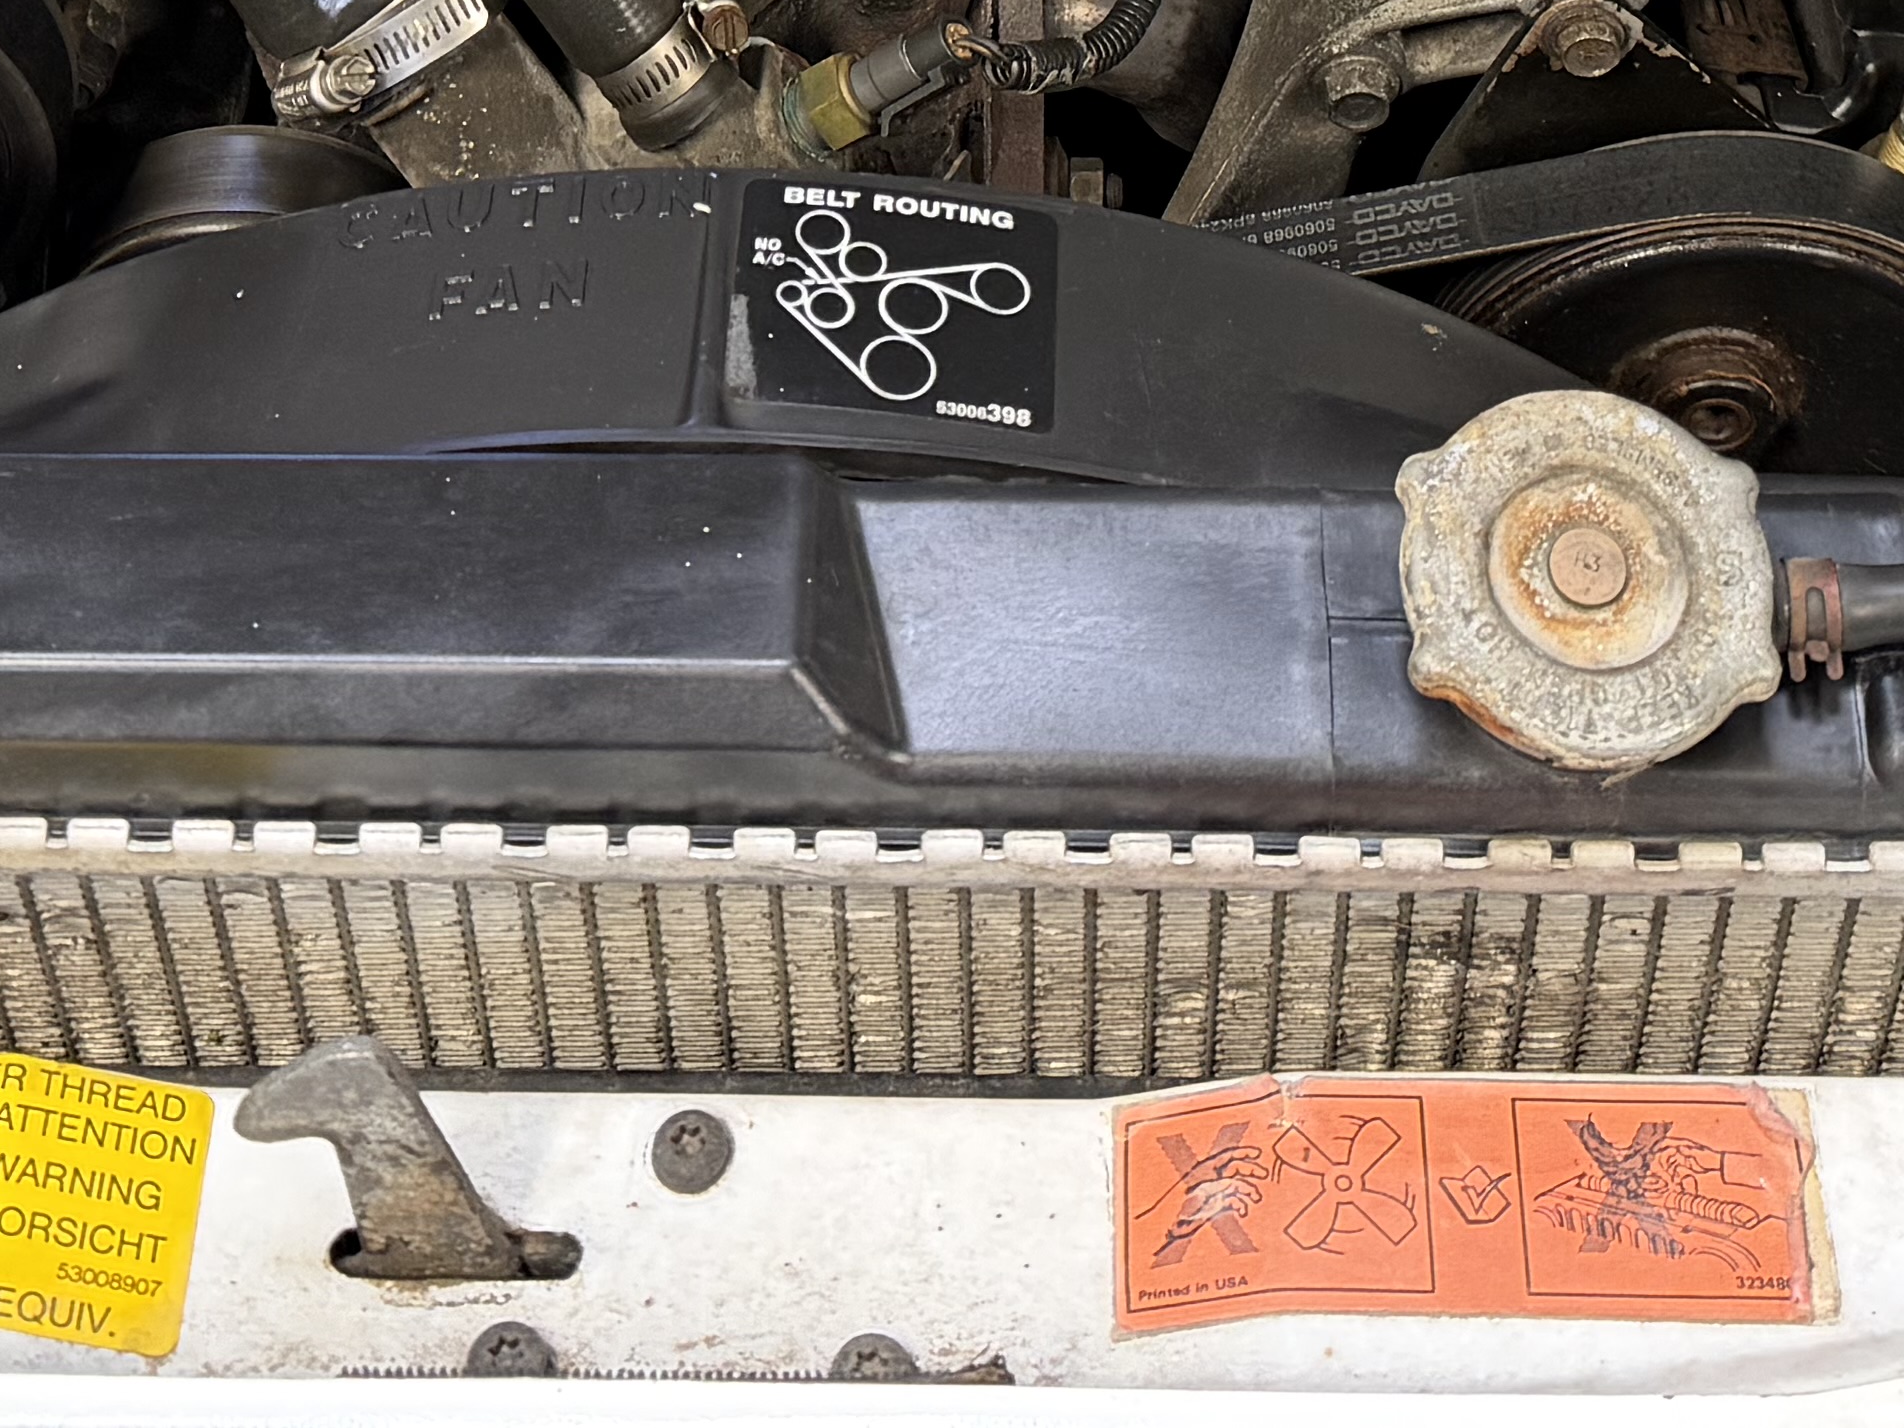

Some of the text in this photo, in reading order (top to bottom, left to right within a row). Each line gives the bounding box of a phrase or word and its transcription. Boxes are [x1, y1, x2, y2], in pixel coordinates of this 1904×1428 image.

[339, 175, 711, 248] CAUTION
[783, 186, 1015, 230] BELT ROUTING
[1352, 192, 1454, 225] DAYCO
[754, 237, 782, 251] NO
[1356, 212, 1458, 244] DAYCO
[752, 250, 786, 266] A/C
[428, 257, 589, 321] FAN
[40, 1068, 186, 1122] THREAD
[56, 1262, 163, 1297] 53008907
[1138, 1275, 1248, 1302] Printed in USA
